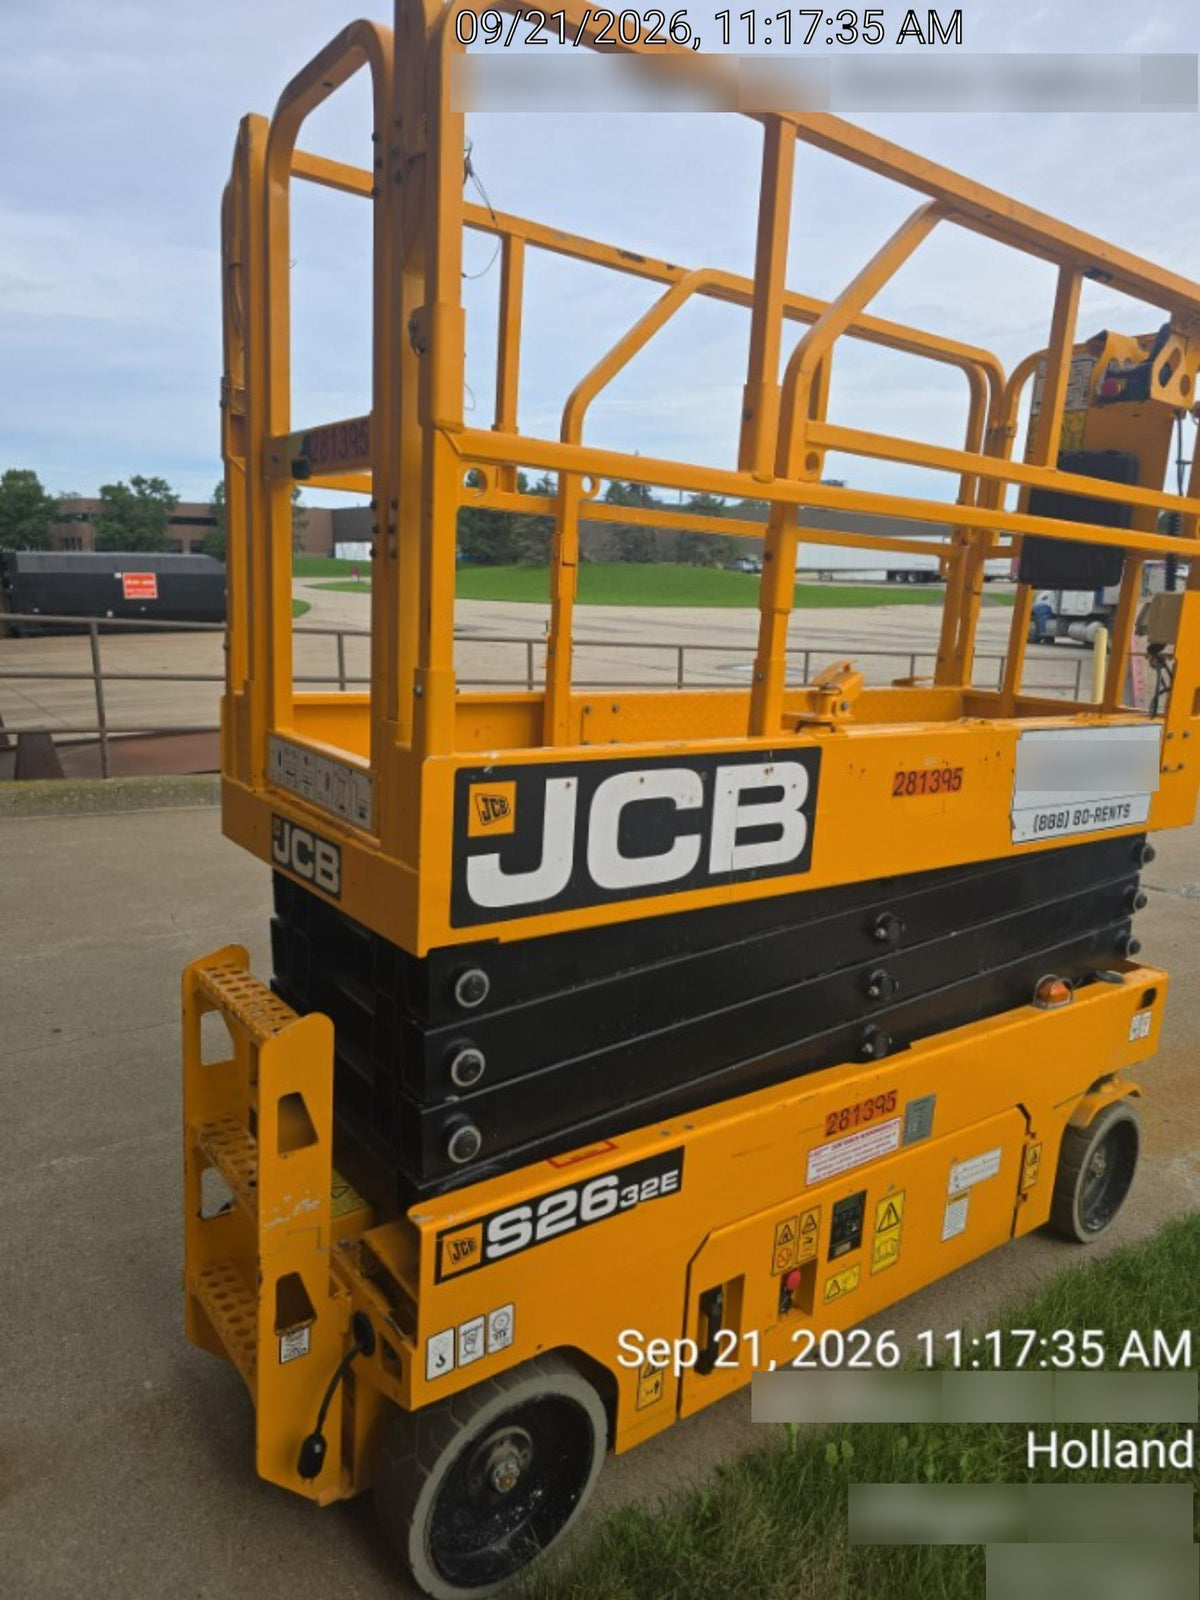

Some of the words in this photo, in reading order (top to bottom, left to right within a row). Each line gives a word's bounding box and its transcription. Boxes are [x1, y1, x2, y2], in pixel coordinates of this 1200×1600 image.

[892, 767, 963, 797] 281395
[481, 796, 508, 821] JCB
[1033, 811, 1069, 833] (888)
[467, 761, 808, 907] JCB
[273, 820, 341, 895] JCB
[825, 1089, 898, 1137] 281395
[450, 1238, 477, 1262] JCB
